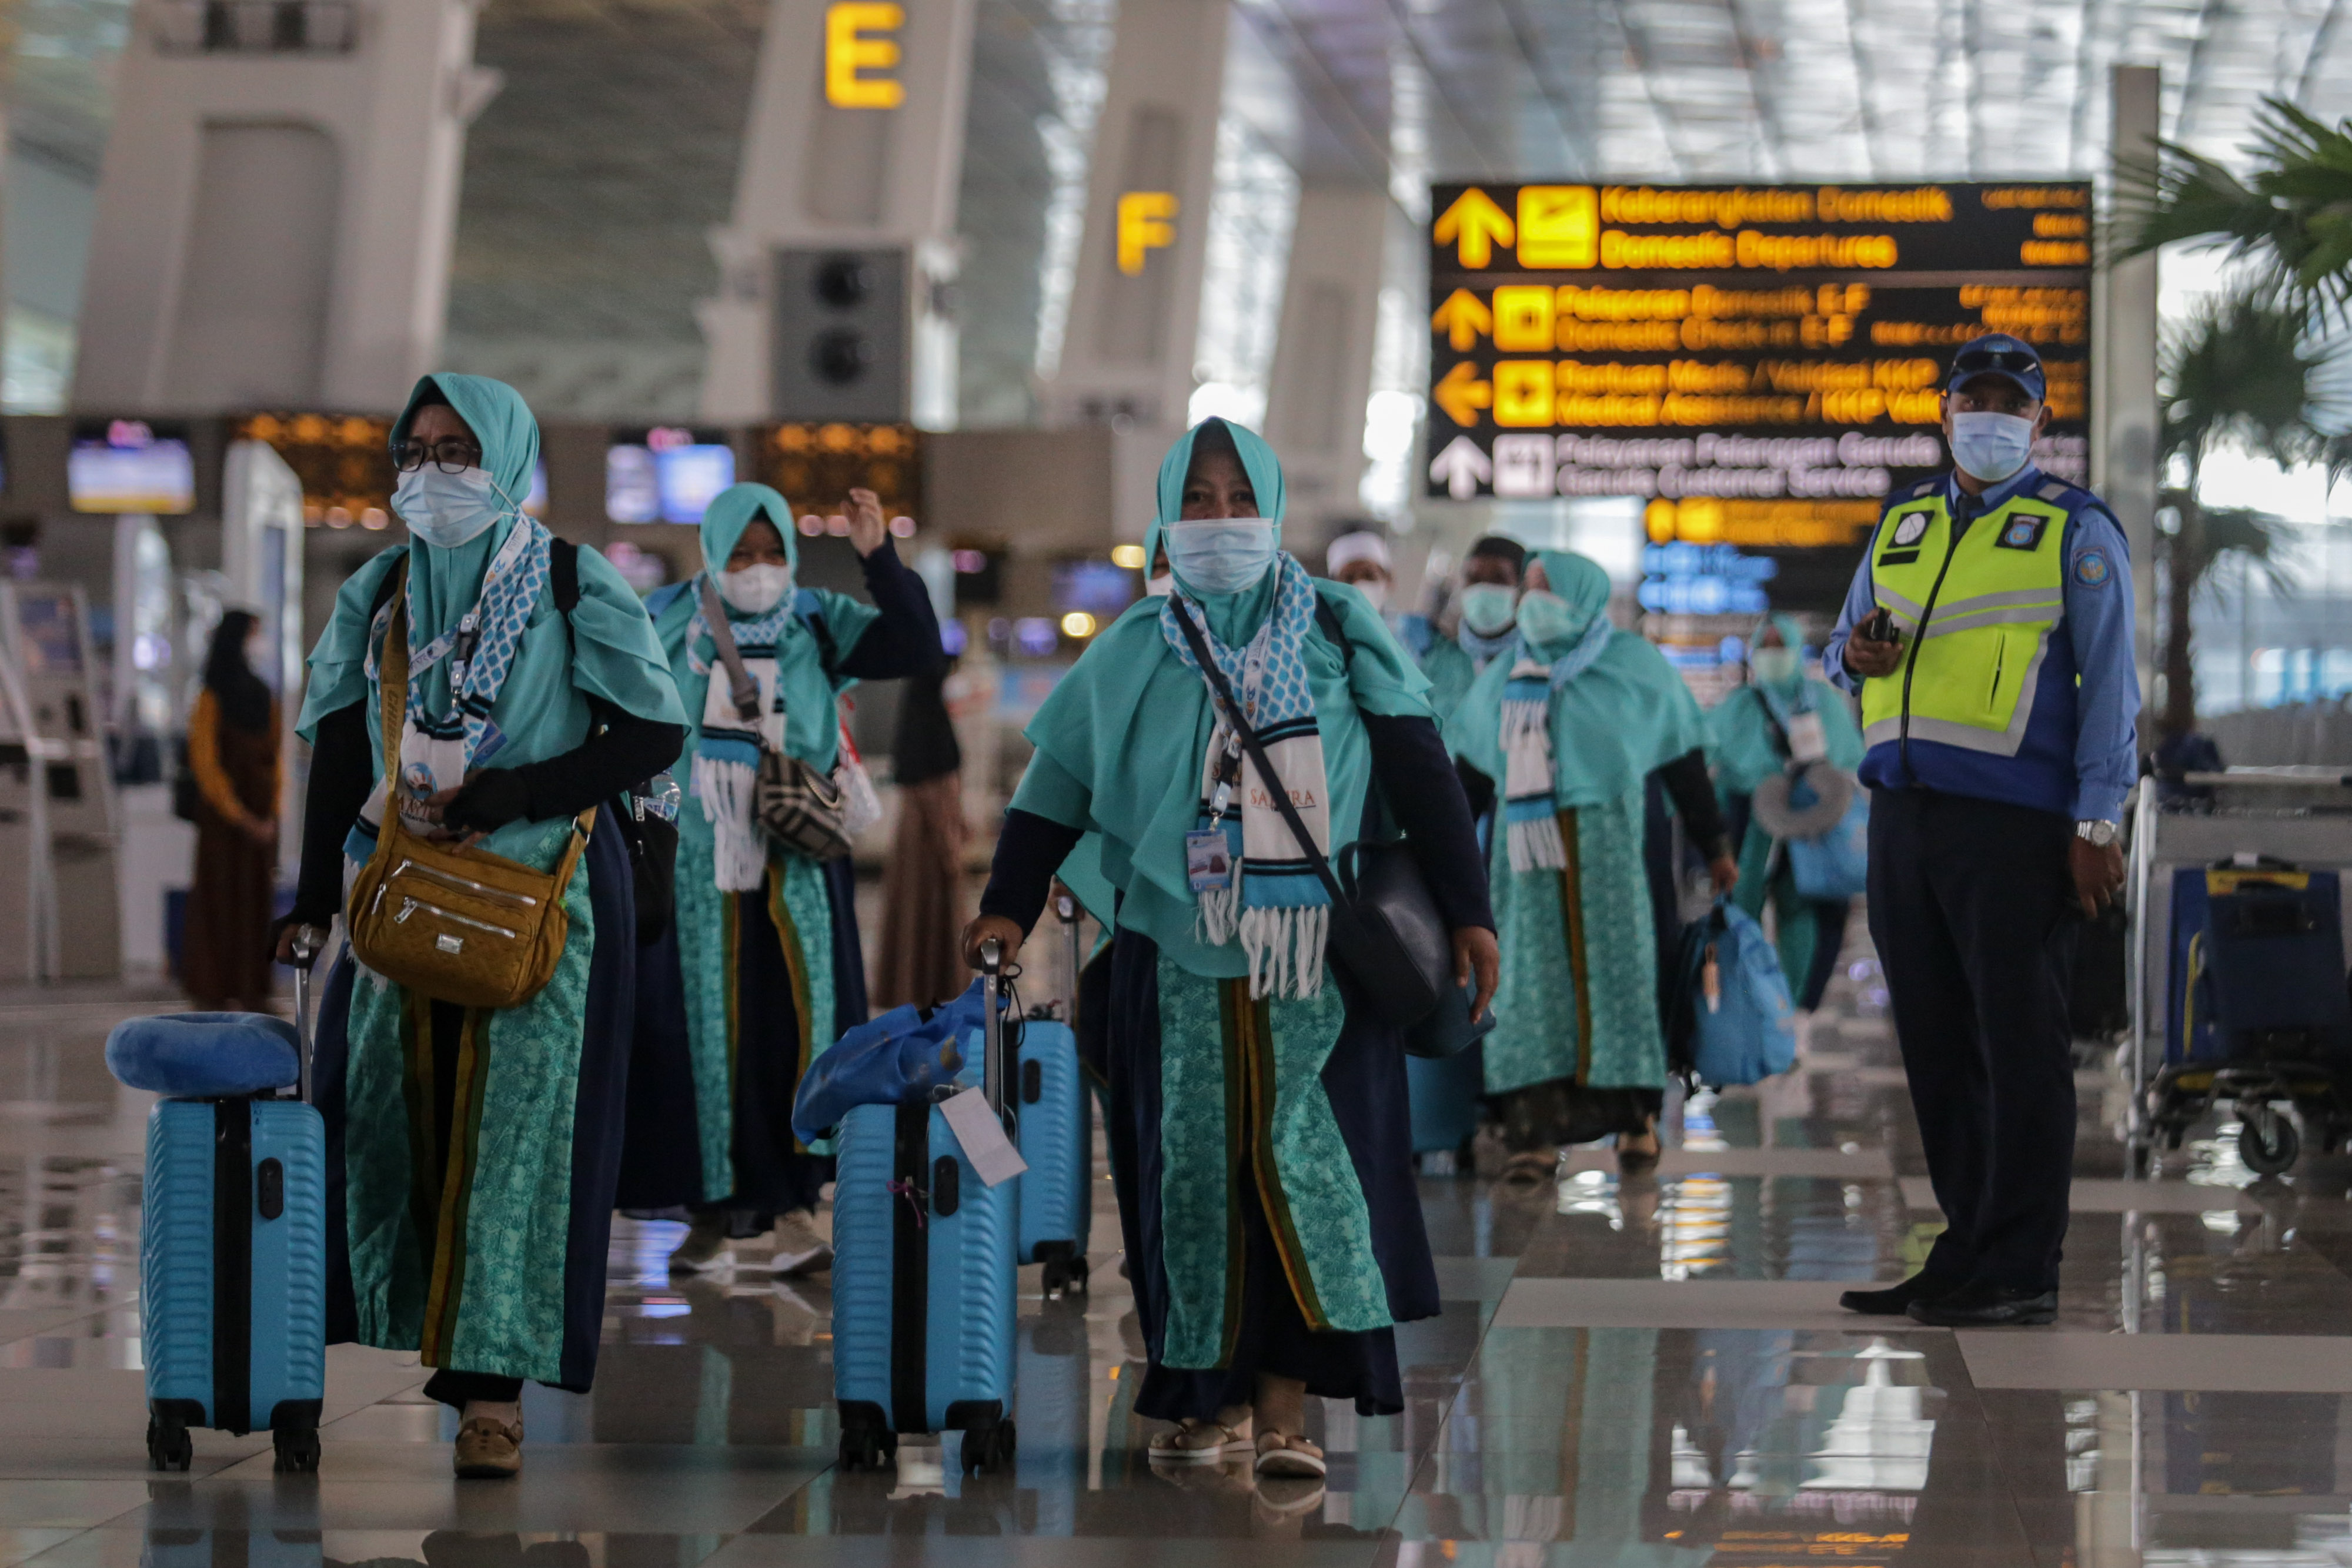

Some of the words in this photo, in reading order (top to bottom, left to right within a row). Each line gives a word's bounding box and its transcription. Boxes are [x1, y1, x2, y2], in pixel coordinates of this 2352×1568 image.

[824, 1, 906, 109] E
[1117, 191, 1179, 276] F
[1250, 788, 1316, 807] SARA
